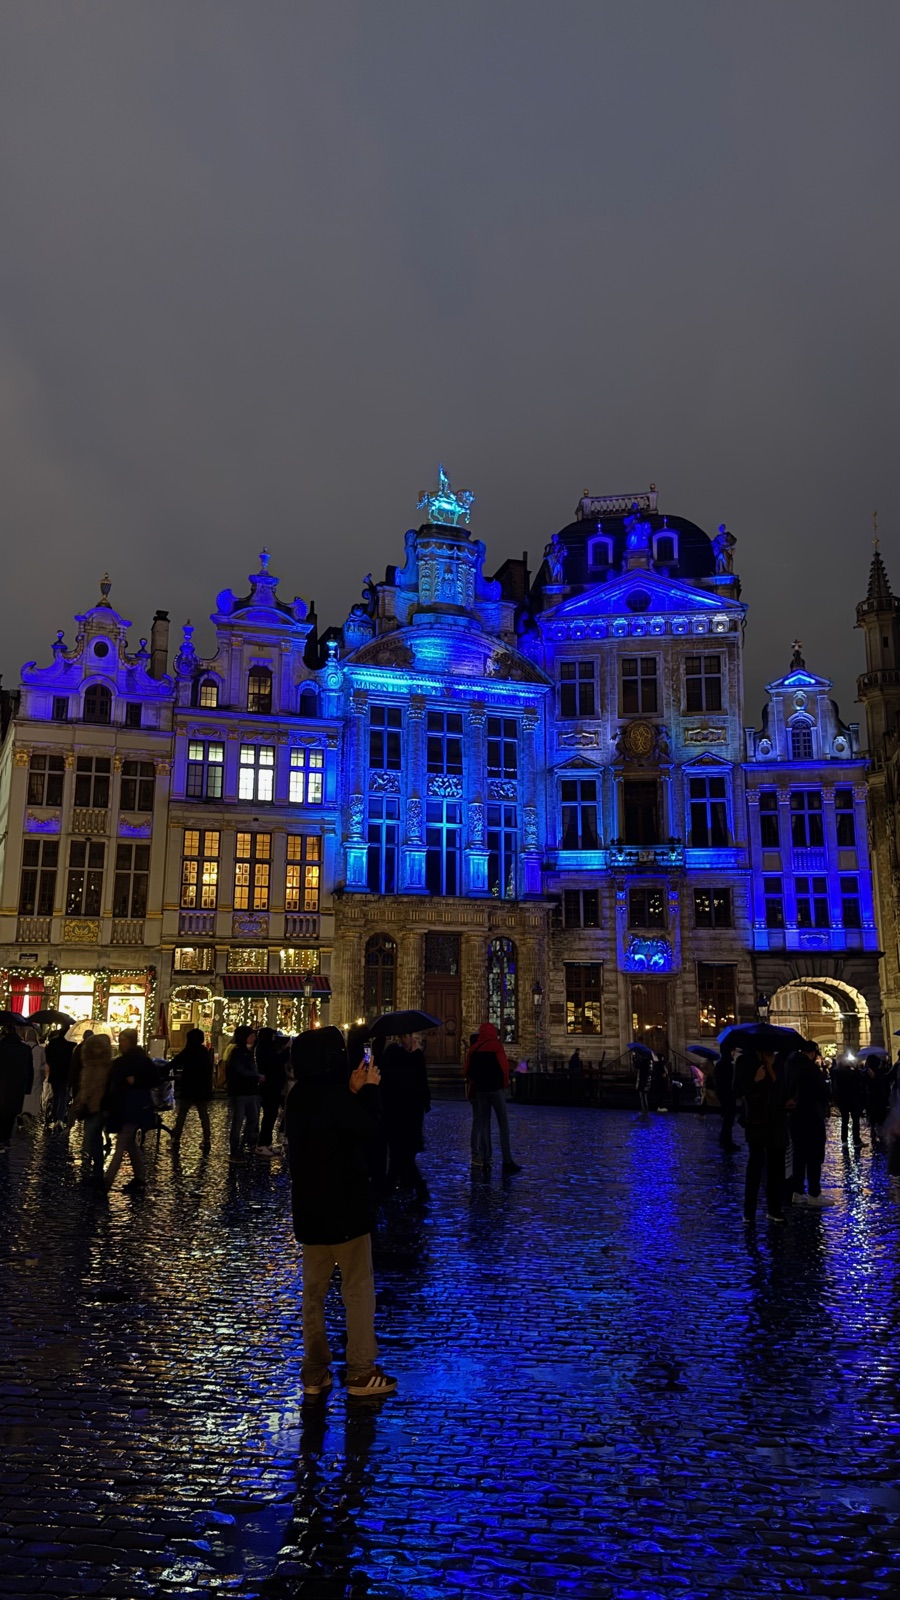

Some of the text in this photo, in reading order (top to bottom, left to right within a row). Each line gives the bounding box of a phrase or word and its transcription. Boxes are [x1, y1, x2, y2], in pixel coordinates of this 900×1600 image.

[354, 681, 537, 706] MAISON DES BRASSEURS
